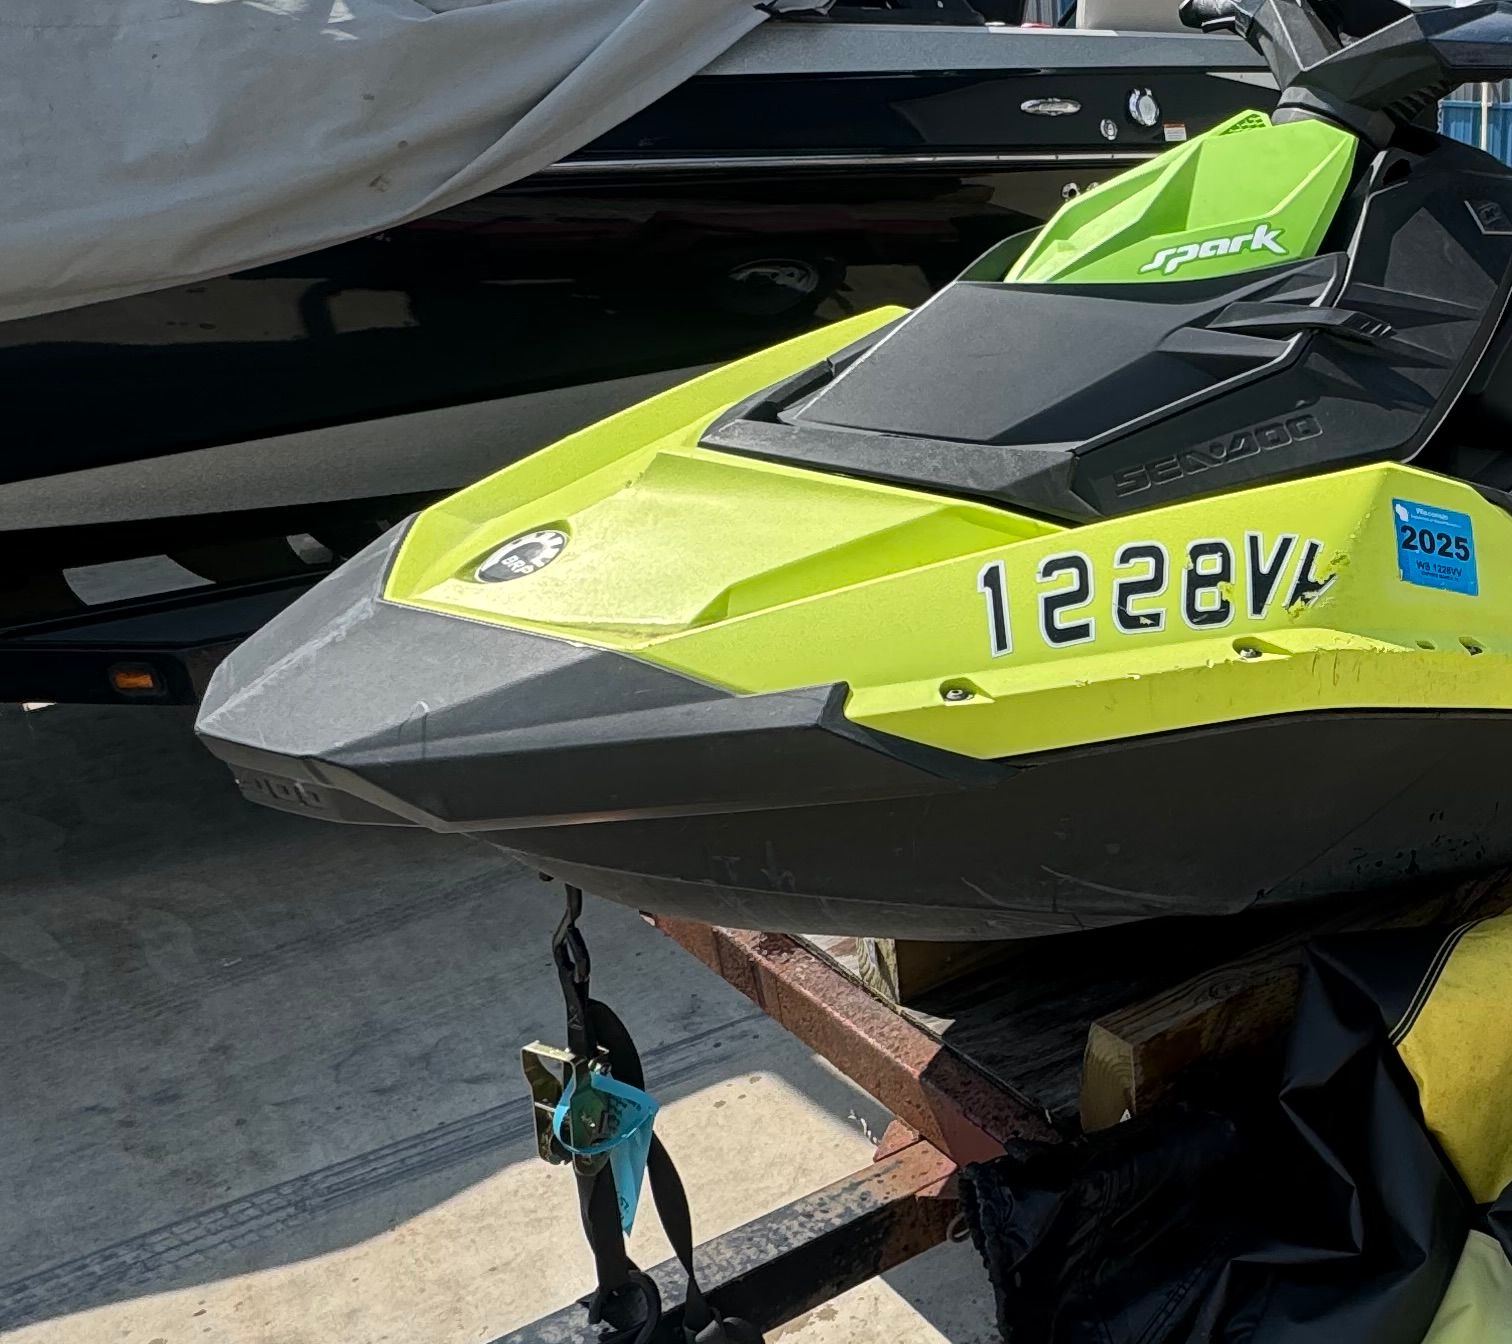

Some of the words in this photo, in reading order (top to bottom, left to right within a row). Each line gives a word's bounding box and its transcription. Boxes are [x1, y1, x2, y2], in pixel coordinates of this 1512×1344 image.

[1139, 223, 1287, 274] spark
[1400, 524, 1471, 562] 2025
[501, 554, 534, 574] BRP
